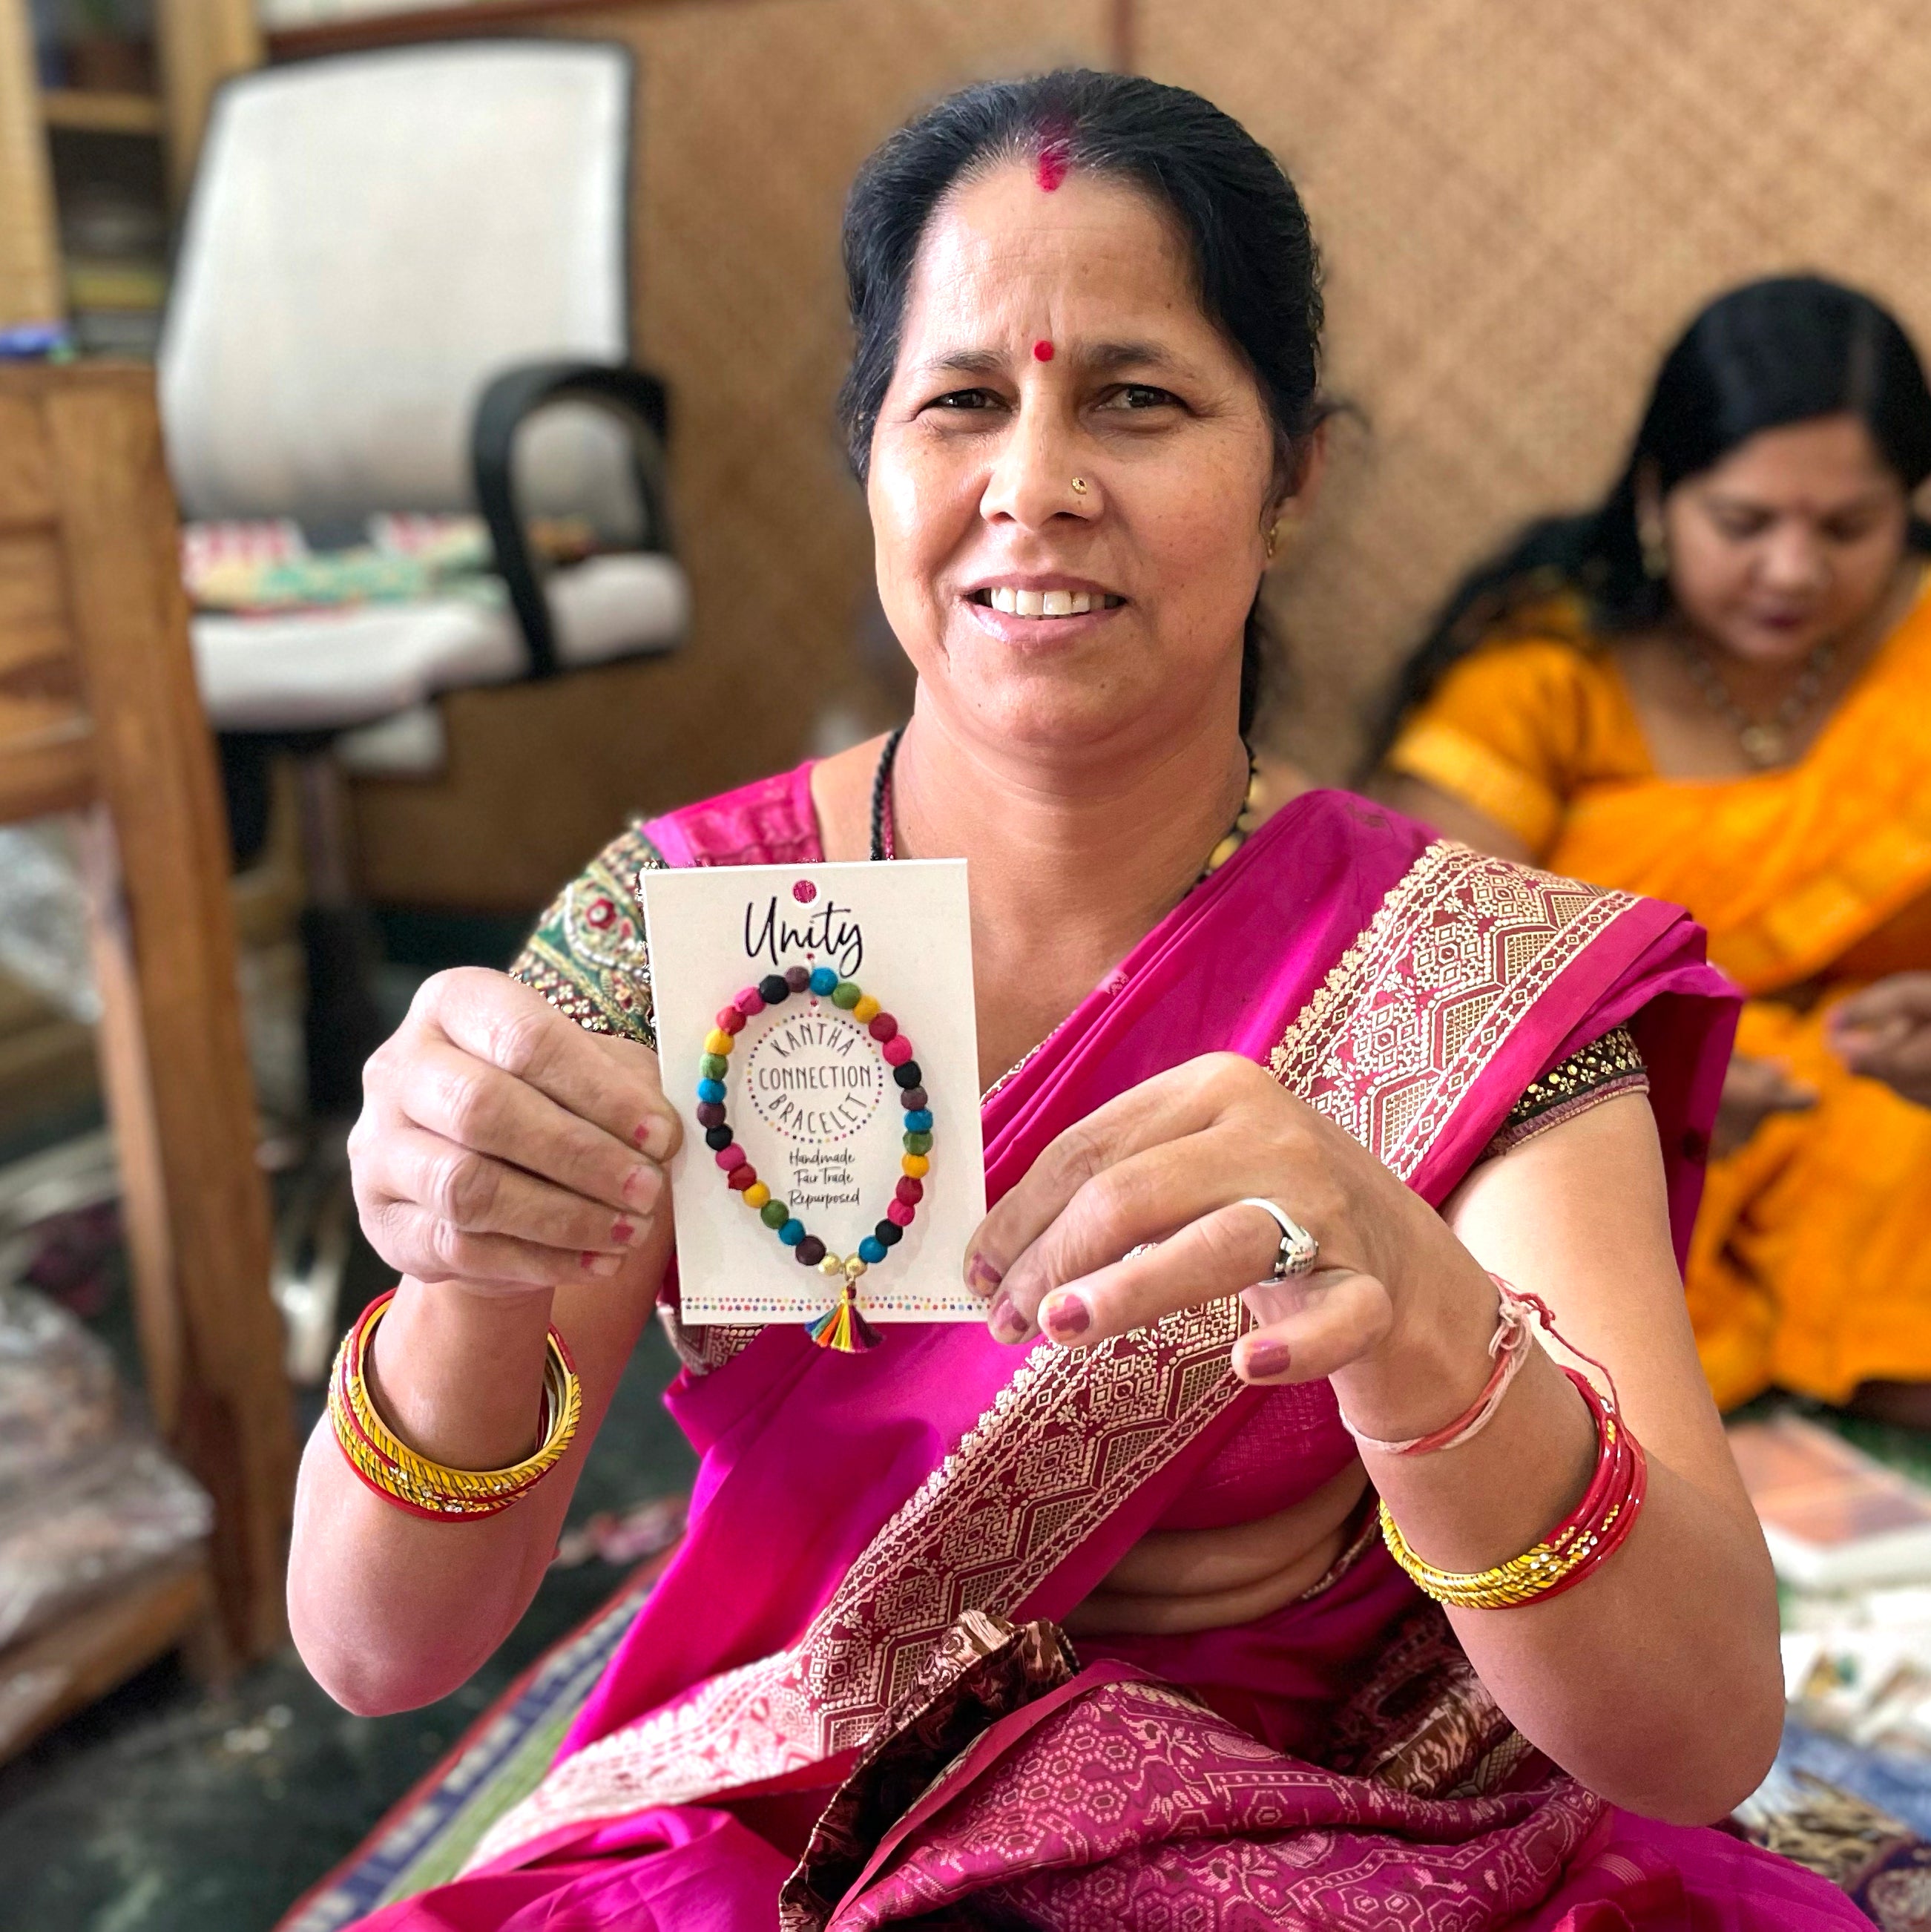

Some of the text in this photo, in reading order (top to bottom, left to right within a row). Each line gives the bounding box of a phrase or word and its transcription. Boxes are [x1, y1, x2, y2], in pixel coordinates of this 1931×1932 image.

[745, 896, 863, 979] Unity
[770, 1022, 855, 1058] KANTHA
[758, 1065, 871, 1091] CONNECTION
[769, 1092, 867, 1134] BRACELET
[789, 1147, 855, 1166] Handmade
[793, 1166, 854, 1186] Fair Trade
[788, 1187, 860, 1210] Repurposed
